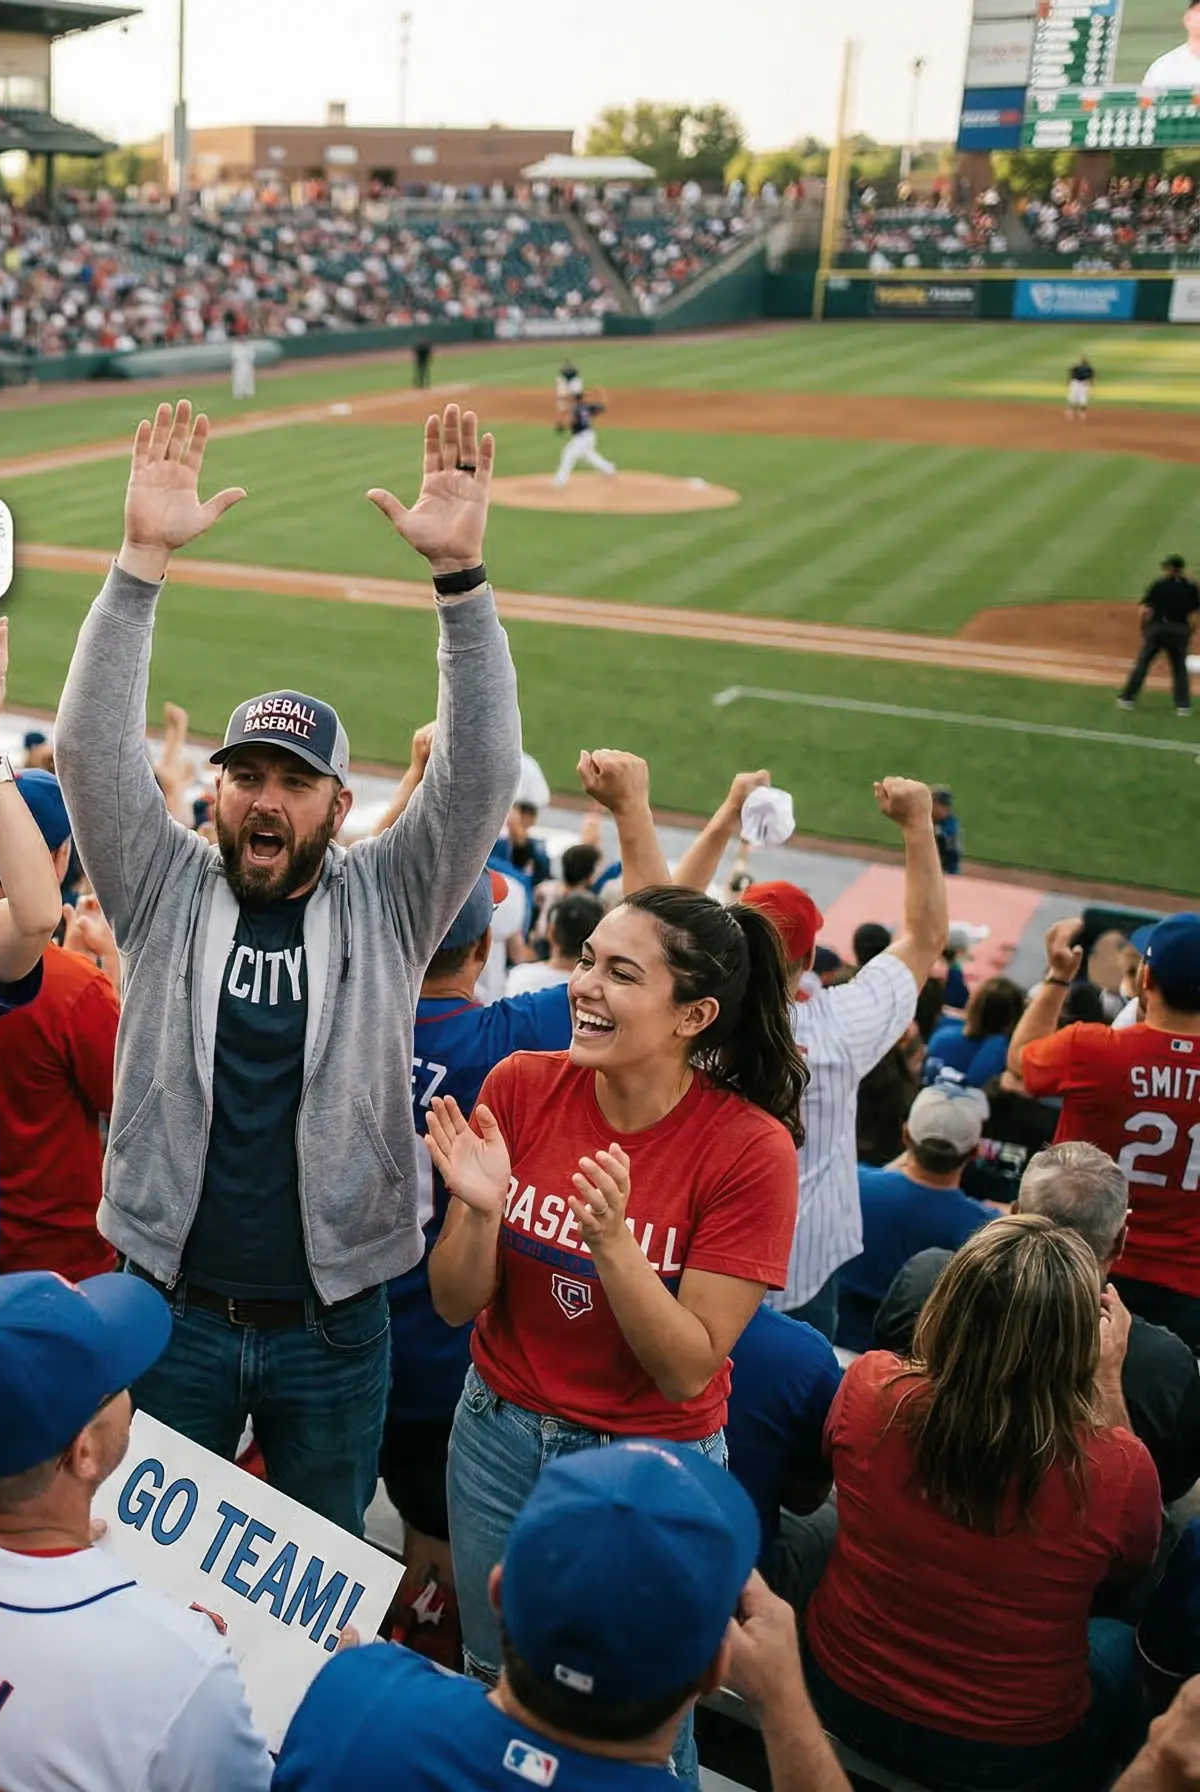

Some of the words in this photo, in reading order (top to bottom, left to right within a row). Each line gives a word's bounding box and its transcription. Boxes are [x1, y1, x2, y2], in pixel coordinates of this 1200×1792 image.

[243, 716, 311, 740] BASEBALL
[245, 698, 317, 727] BASEBALL
[227, 944, 303, 1006] CITY
[1130, 1065, 1200, 1102] SMIT
[503, 1174, 681, 1272] BASELL
[117, 1458, 199, 1546] GO
[199, 1500, 366, 1652] TEAM!
